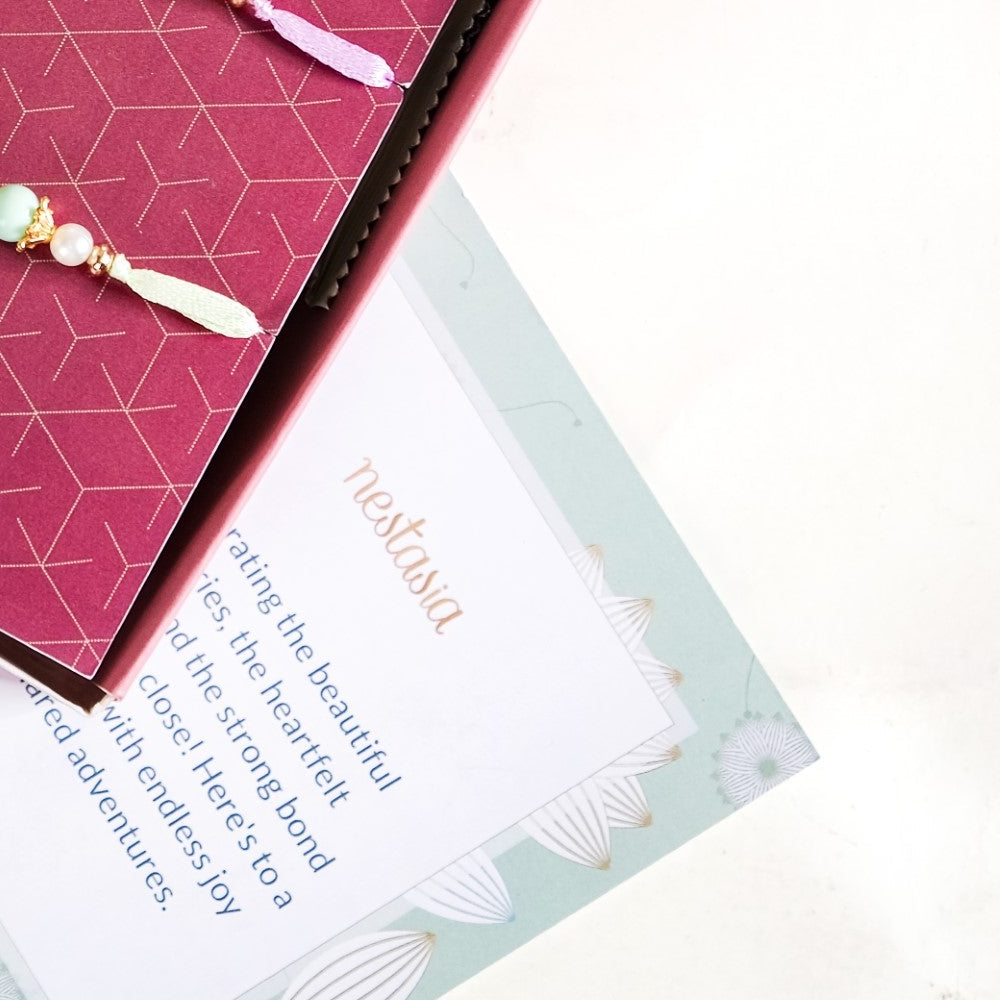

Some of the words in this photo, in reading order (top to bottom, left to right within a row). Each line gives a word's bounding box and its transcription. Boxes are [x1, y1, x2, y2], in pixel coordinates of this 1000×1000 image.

[227, 528, 283, 615] rating
[276, 613, 315, 665] the
[308, 662, 402, 792] beautiful
[344, 457, 463, 634] nestasia
[20, 679, 80, 744] ared
[68, 747, 173, 911] adventures.
[139, 674, 204, 758] close!
[193, 757, 257, 851] Here's
[252, 852, 279, 887] to
[273, 891, 292, 909] a
[165, 618, 198, 652] nd
[185, 654, 222, 703] the
[221, 706, 283, 801] strong
[276, 797, 336, 873] bond
[198, 573, 232, 631] ies,
[230, 630, 267, 681] the
[260, 680, 351, 809] heartfelt
[137, 765, 211, 871] endless
[199, 869, 241, 917] joy
